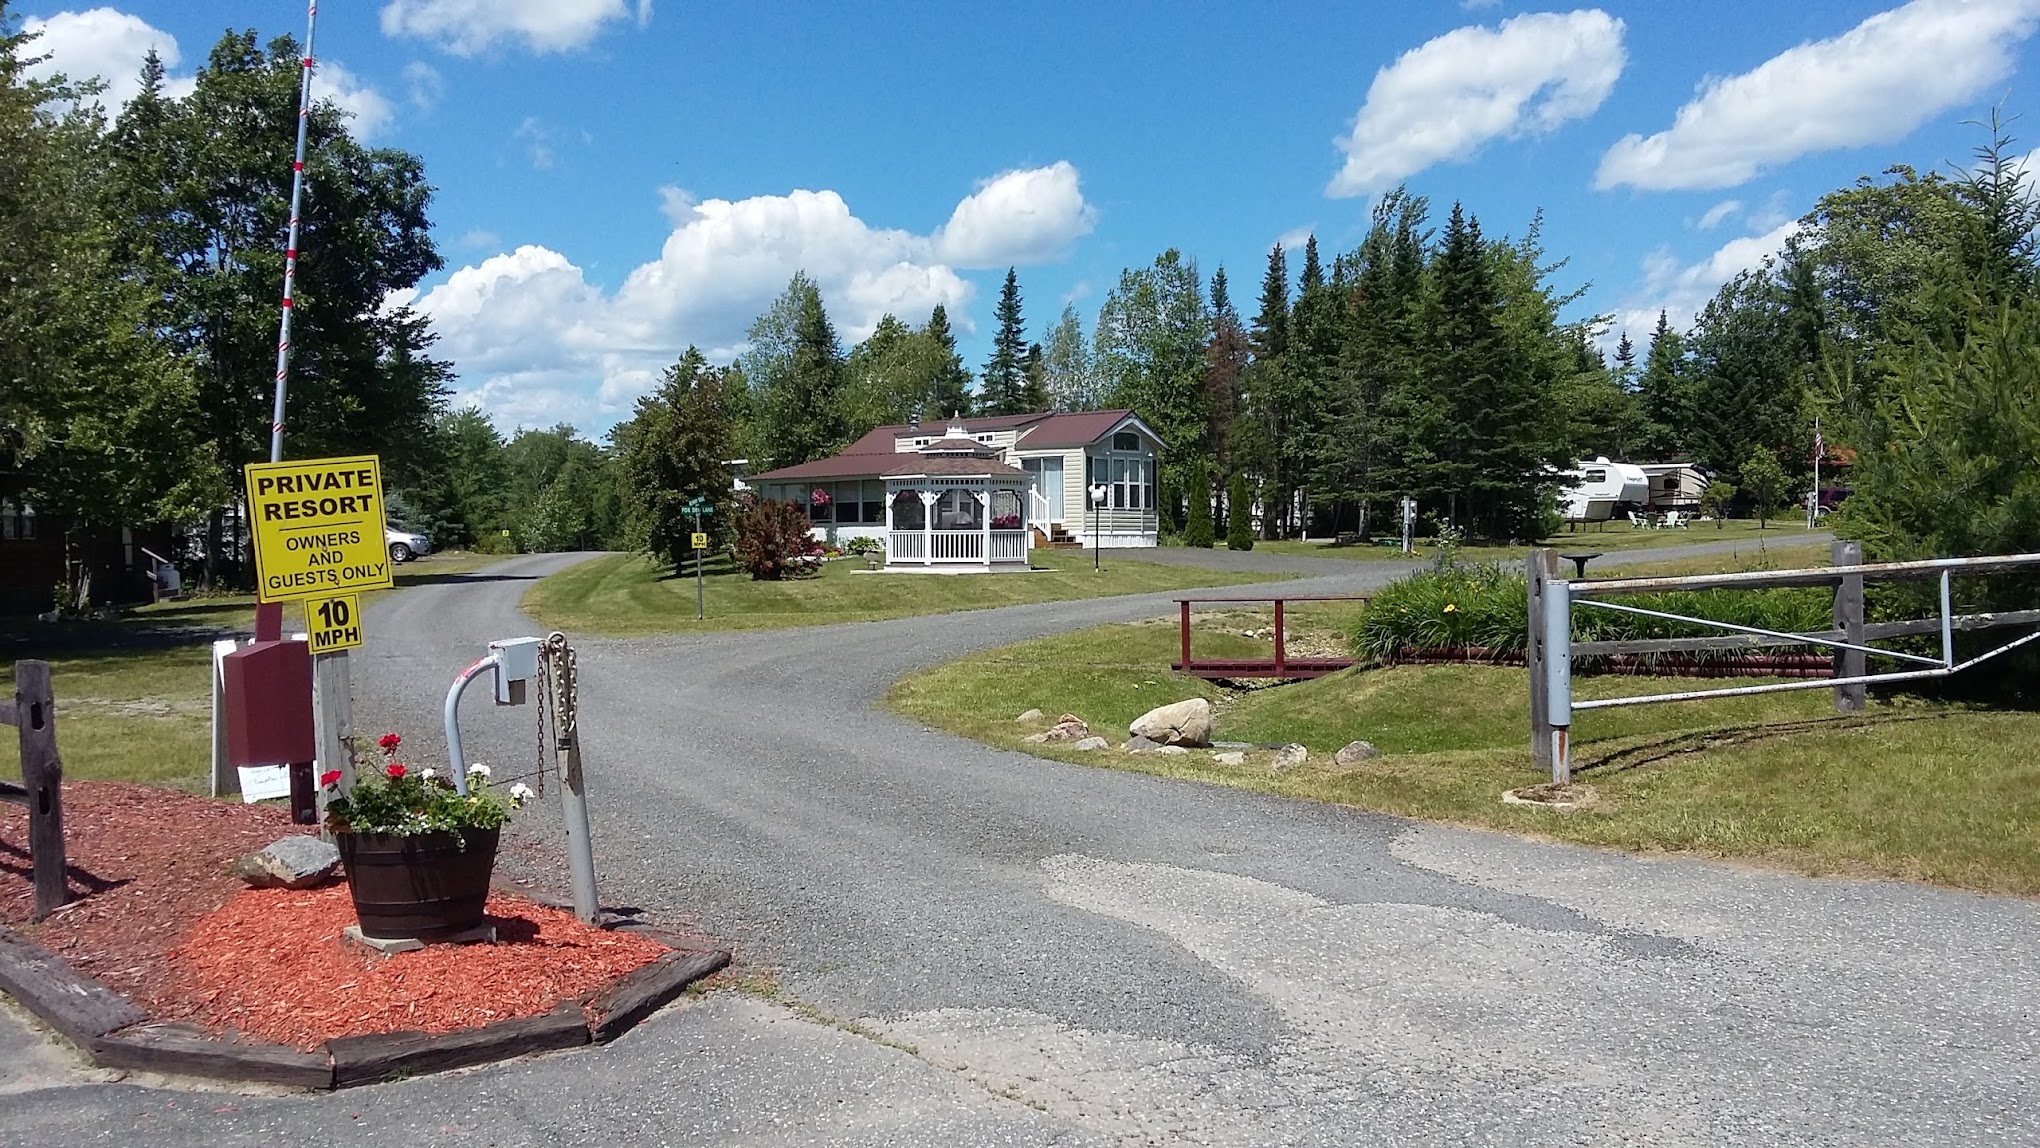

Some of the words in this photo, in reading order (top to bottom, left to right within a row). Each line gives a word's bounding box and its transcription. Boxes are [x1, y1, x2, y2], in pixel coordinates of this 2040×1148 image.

[258, 470, 374, 496] PRIVATE
[264, 495, 373, 521] RESORT
[286, 531, 361, 551] OWNERS
[695, 534, 704, 542] 10
[308, 550, 343, 567] AND
[269, 569, 337, 589] GUESTS
[342, 563, 385, 580] ONLY
[318, 600, 349, 628] 10
[315, 626, 359, 647] MPH
